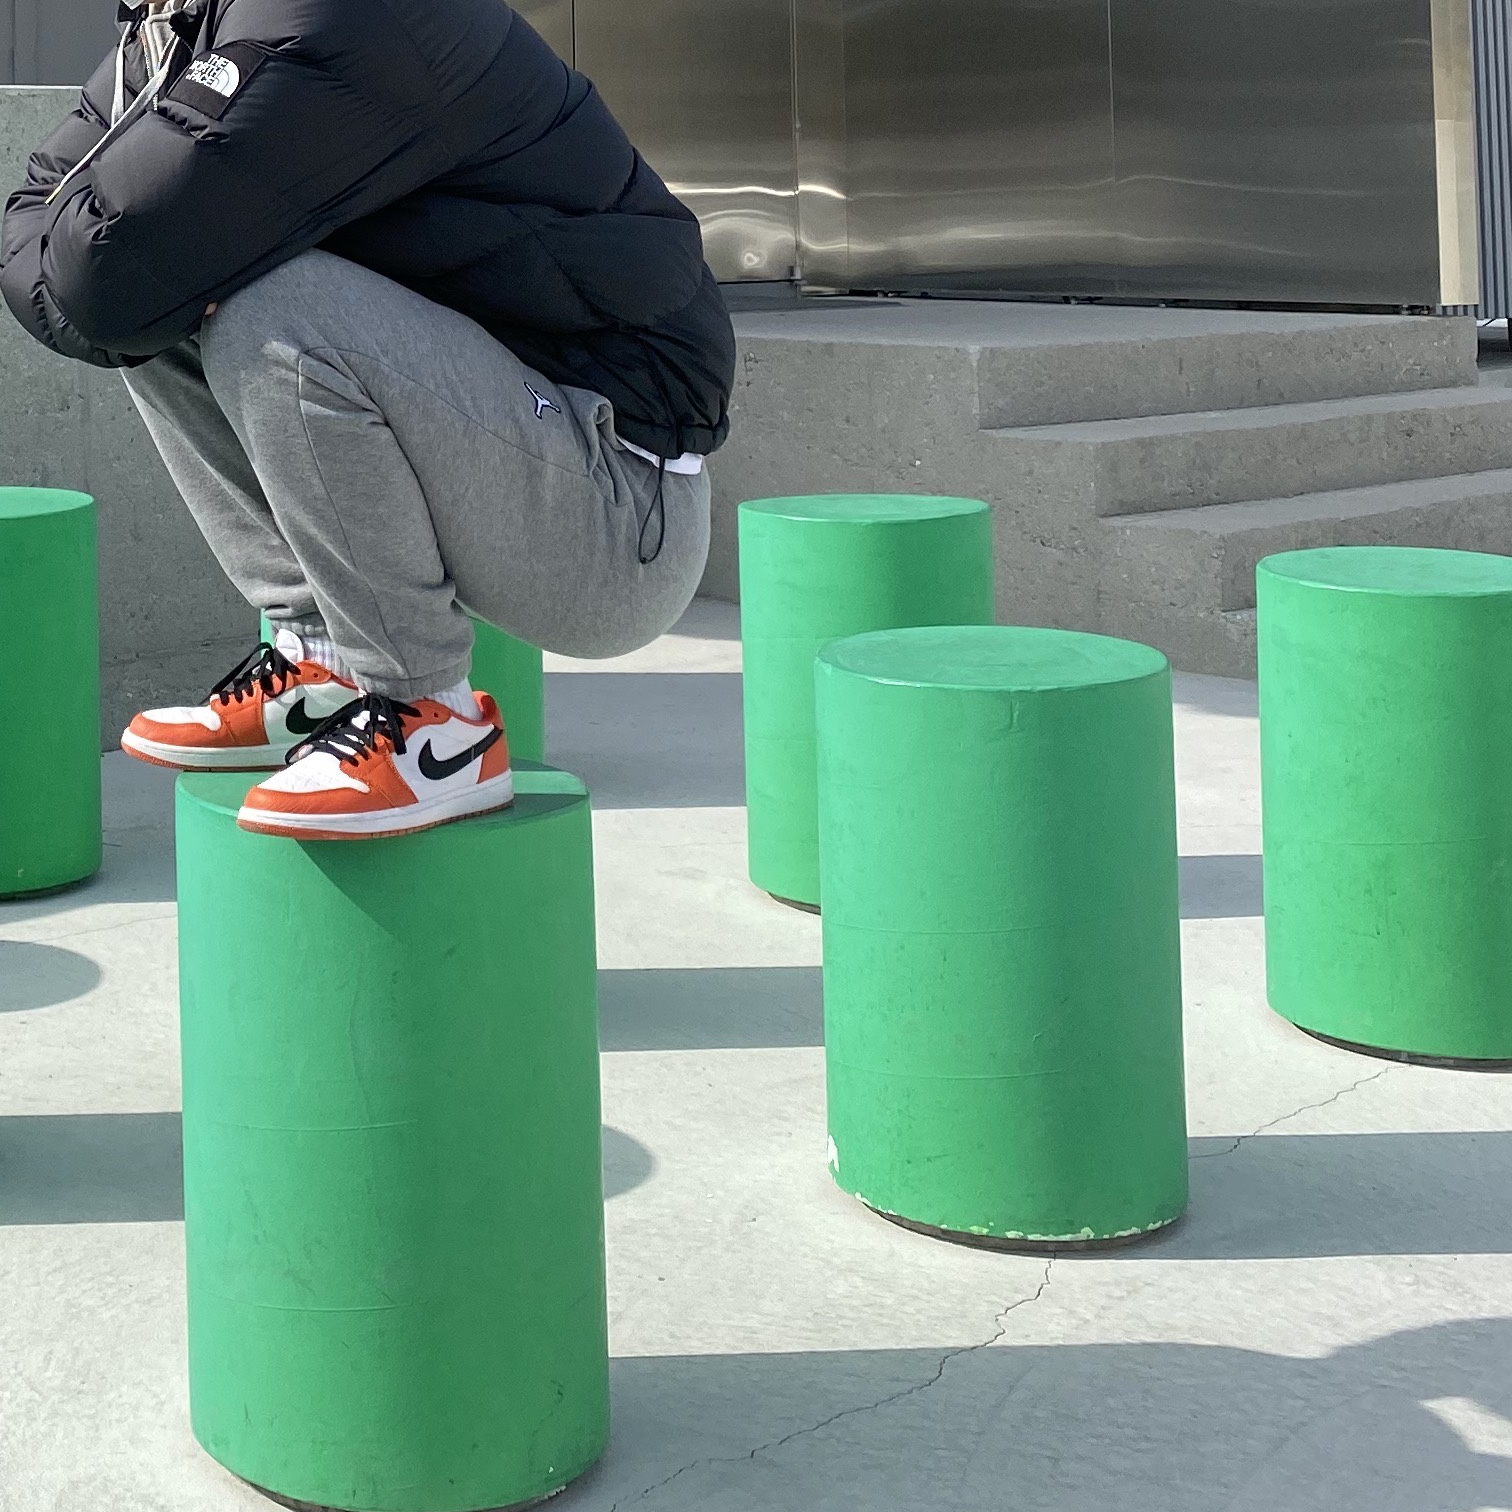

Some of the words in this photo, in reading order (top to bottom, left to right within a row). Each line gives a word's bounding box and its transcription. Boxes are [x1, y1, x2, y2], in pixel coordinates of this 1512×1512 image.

[189, 59, 221, 77] NORTH
[208, 53, 229, 69] THE
[185, 70, 215, 87] FACE
